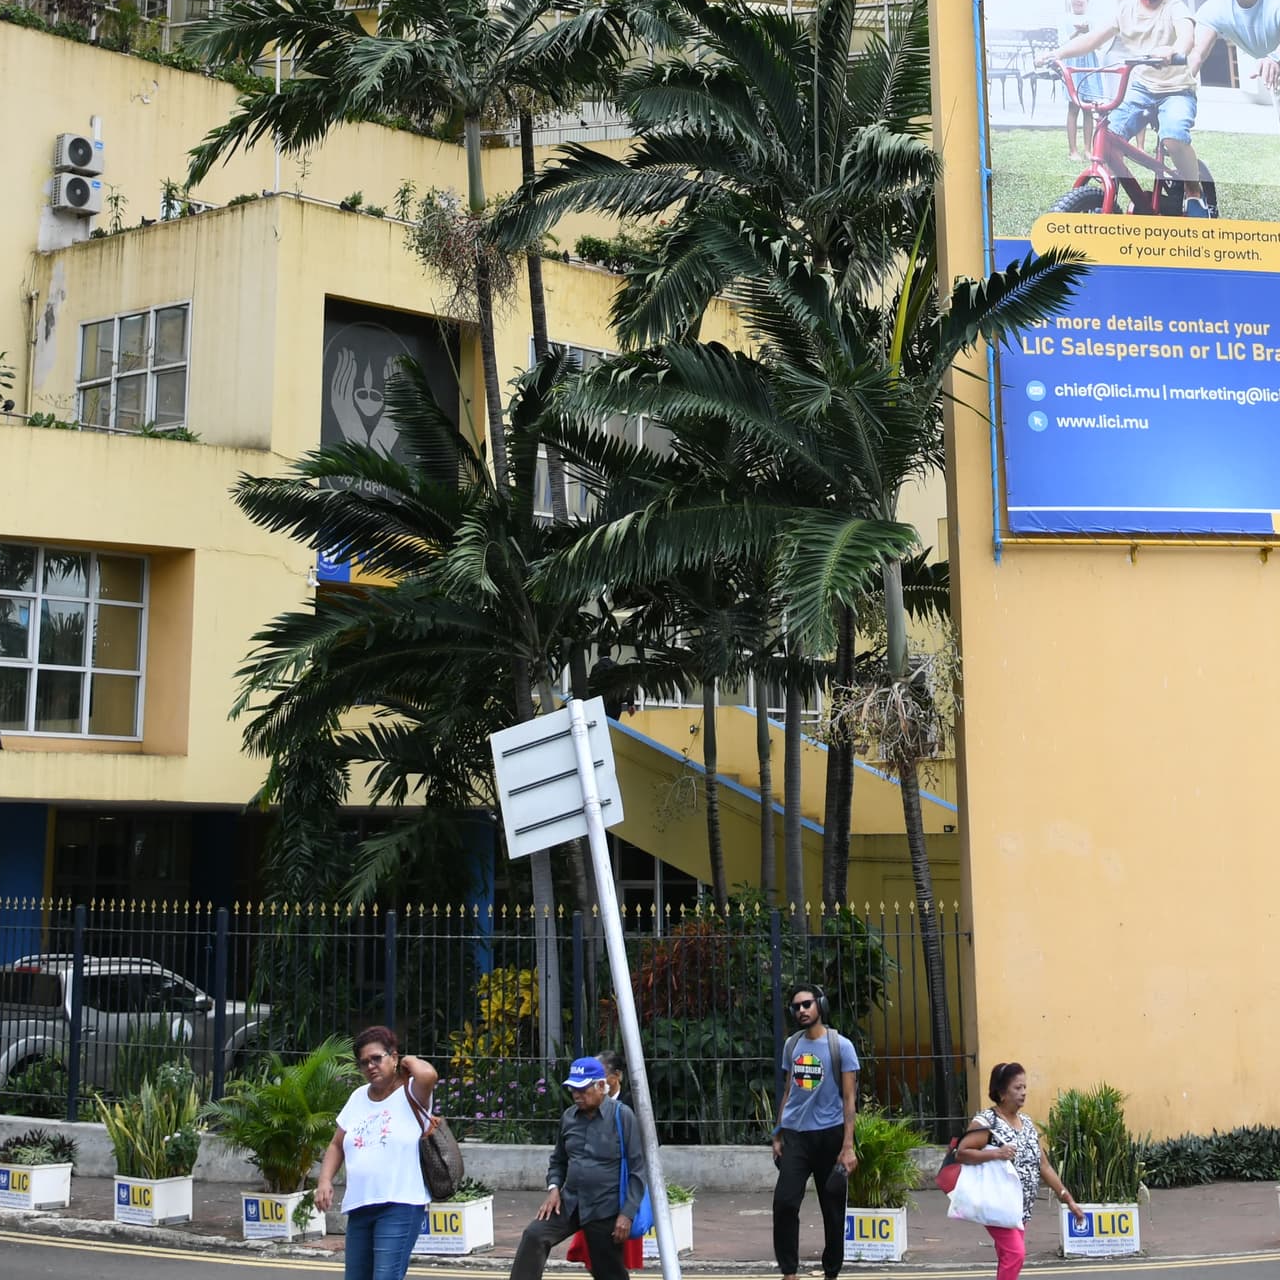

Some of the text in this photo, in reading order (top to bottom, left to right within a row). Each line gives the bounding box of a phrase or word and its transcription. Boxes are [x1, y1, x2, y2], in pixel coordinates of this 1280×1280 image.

[1046, 222, 1070, 234] Get
[1074, 224, 1141, 236] attractive
[1144, 227, 1198, 240] payouts
[1202, 229, 1215, 239] at
[1120, 244, 1262, 262] of your child's growth.
[1056, 316, 1101, 330] more
[1107, 314, 1164, 332] details
[1168, 318, 1230, 334] contact
[1234, 322, 1270, 338] your
[1022, 336, 1055, 355] LIC
[1061, 337, 1183, 361] Salesperson
[1190, 344, 1210, 359] or
[1216, 342, 1246, 360] LIC
[1055, 382, 1160, 401] chief@lici.mu
[1056, 414, 1149, 429] www.lici.mu
[11, 1172, 28, 1191] LIC
[132, 1187, 150, 1206] LIC
[262, 1201, 283, 1220] LIC
[433, 1213, 459, 1232] LIC
[859, 1219, 890, 1239] LIC
[1098, 1214, 1129, 1234] LIC
